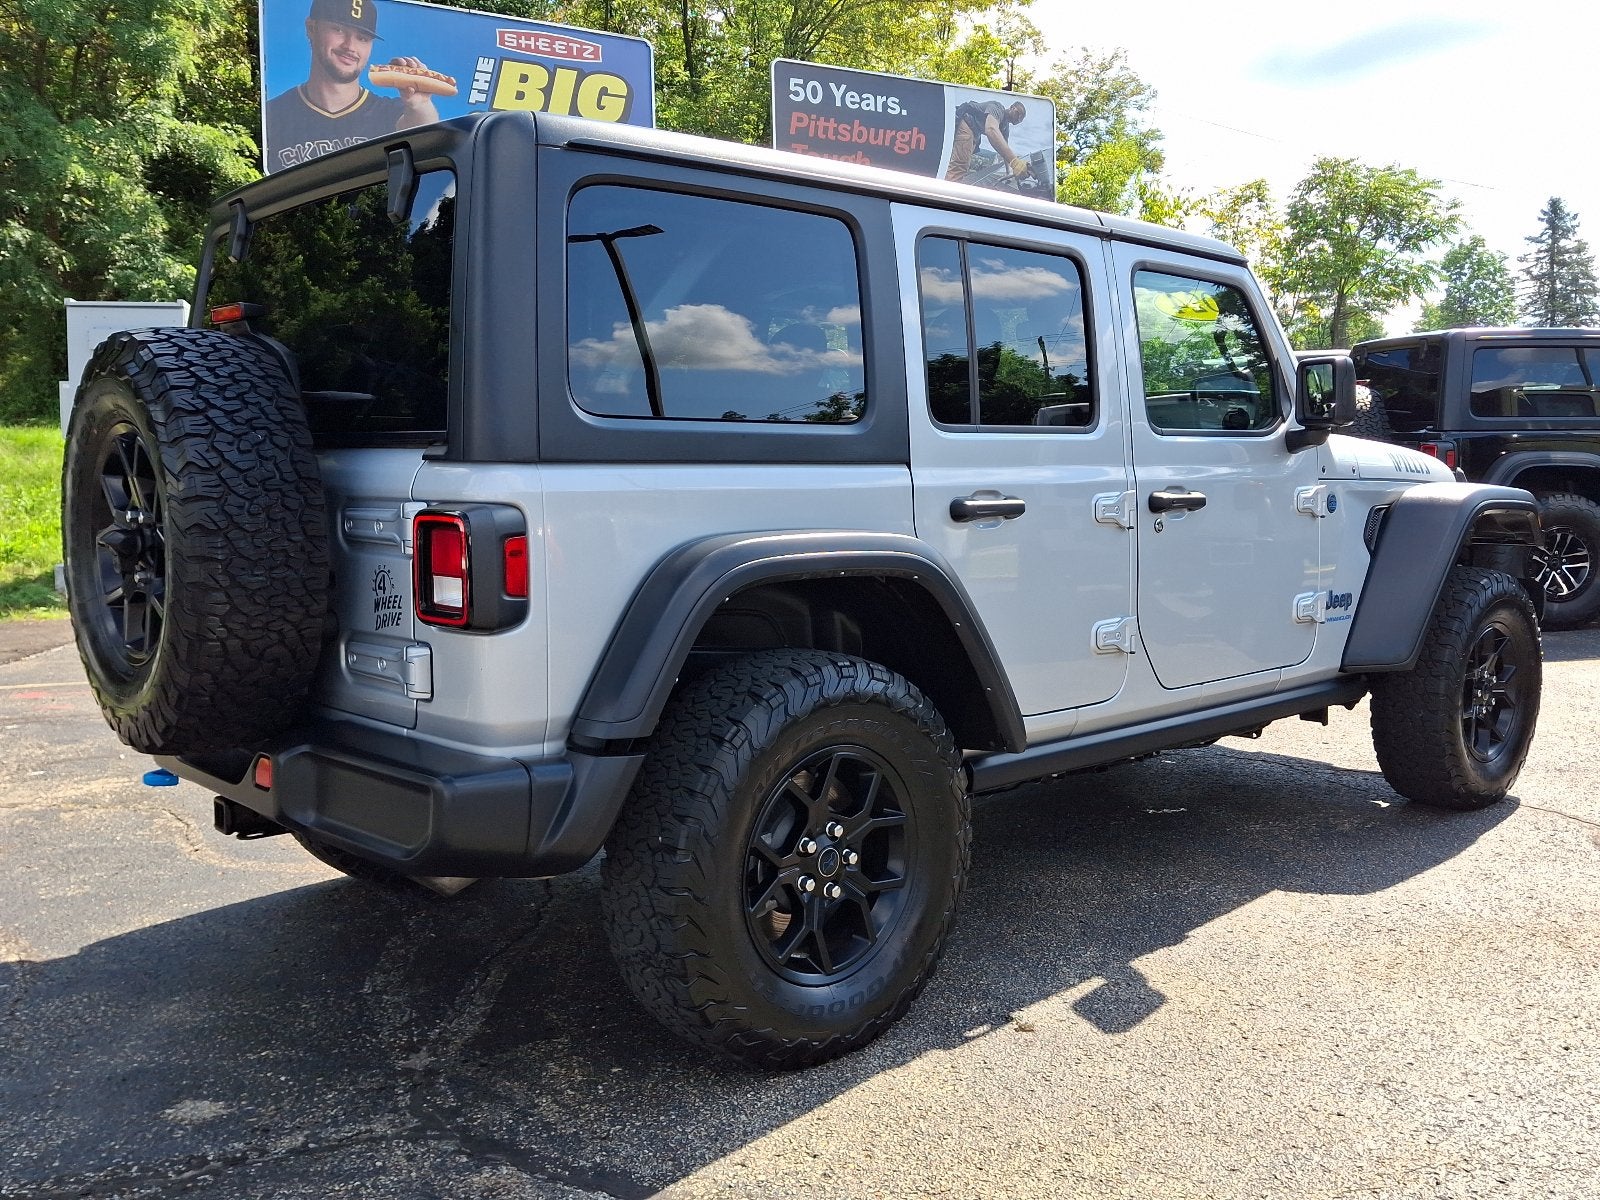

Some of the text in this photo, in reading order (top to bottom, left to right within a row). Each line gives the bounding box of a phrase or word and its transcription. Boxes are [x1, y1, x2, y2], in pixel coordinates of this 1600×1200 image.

[504, 33, 595, 59] SHEETZ
[469, 56, 495, 104] THE
[492, 60, 628, 122] BIG
[789, 77, 908, 116] 50 Years.
[789, 112, 926, 155] Pittsburgh
[373, 595, 402, 613] WHEEL
[1326, 590, 1353, 611] Jeep
[375, 612, 402, 631] DRIVE
